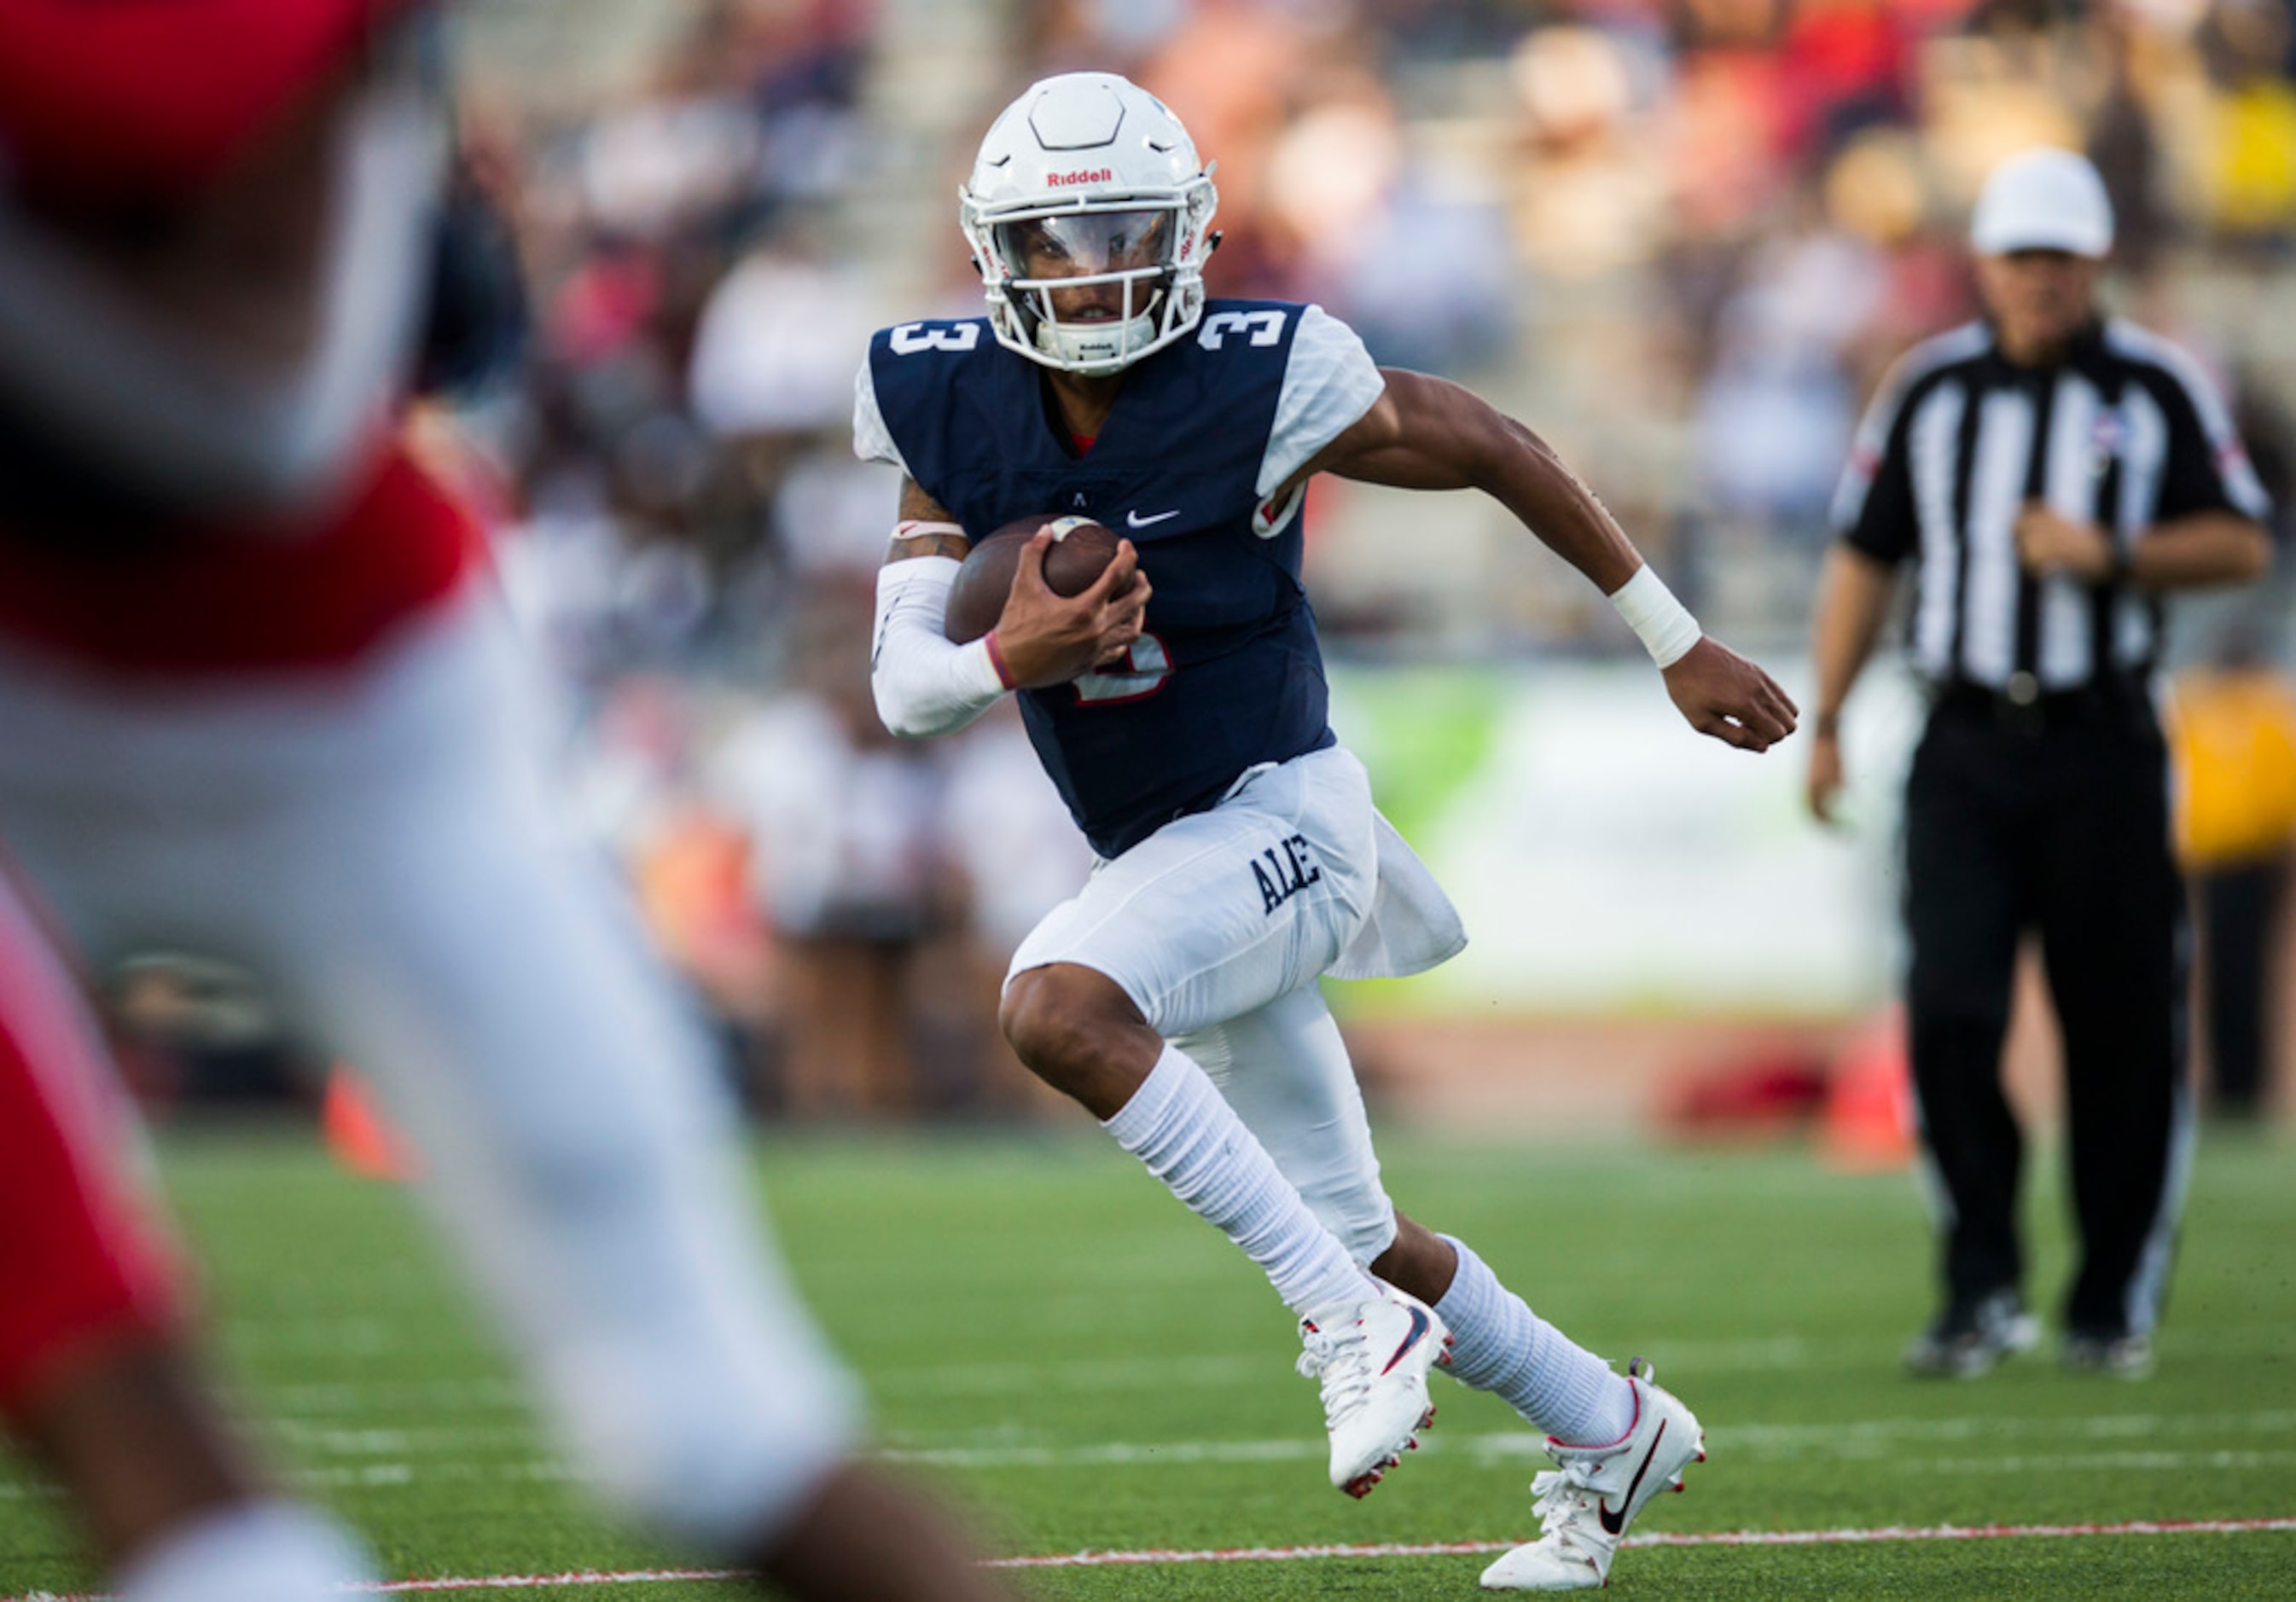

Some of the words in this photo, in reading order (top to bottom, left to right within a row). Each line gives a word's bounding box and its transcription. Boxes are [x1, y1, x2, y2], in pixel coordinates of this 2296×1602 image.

[1047, 168, 1112, 187] Riddell
[889, 322, 980, 356] 3
[1197, 310, 1288, 351] 3
